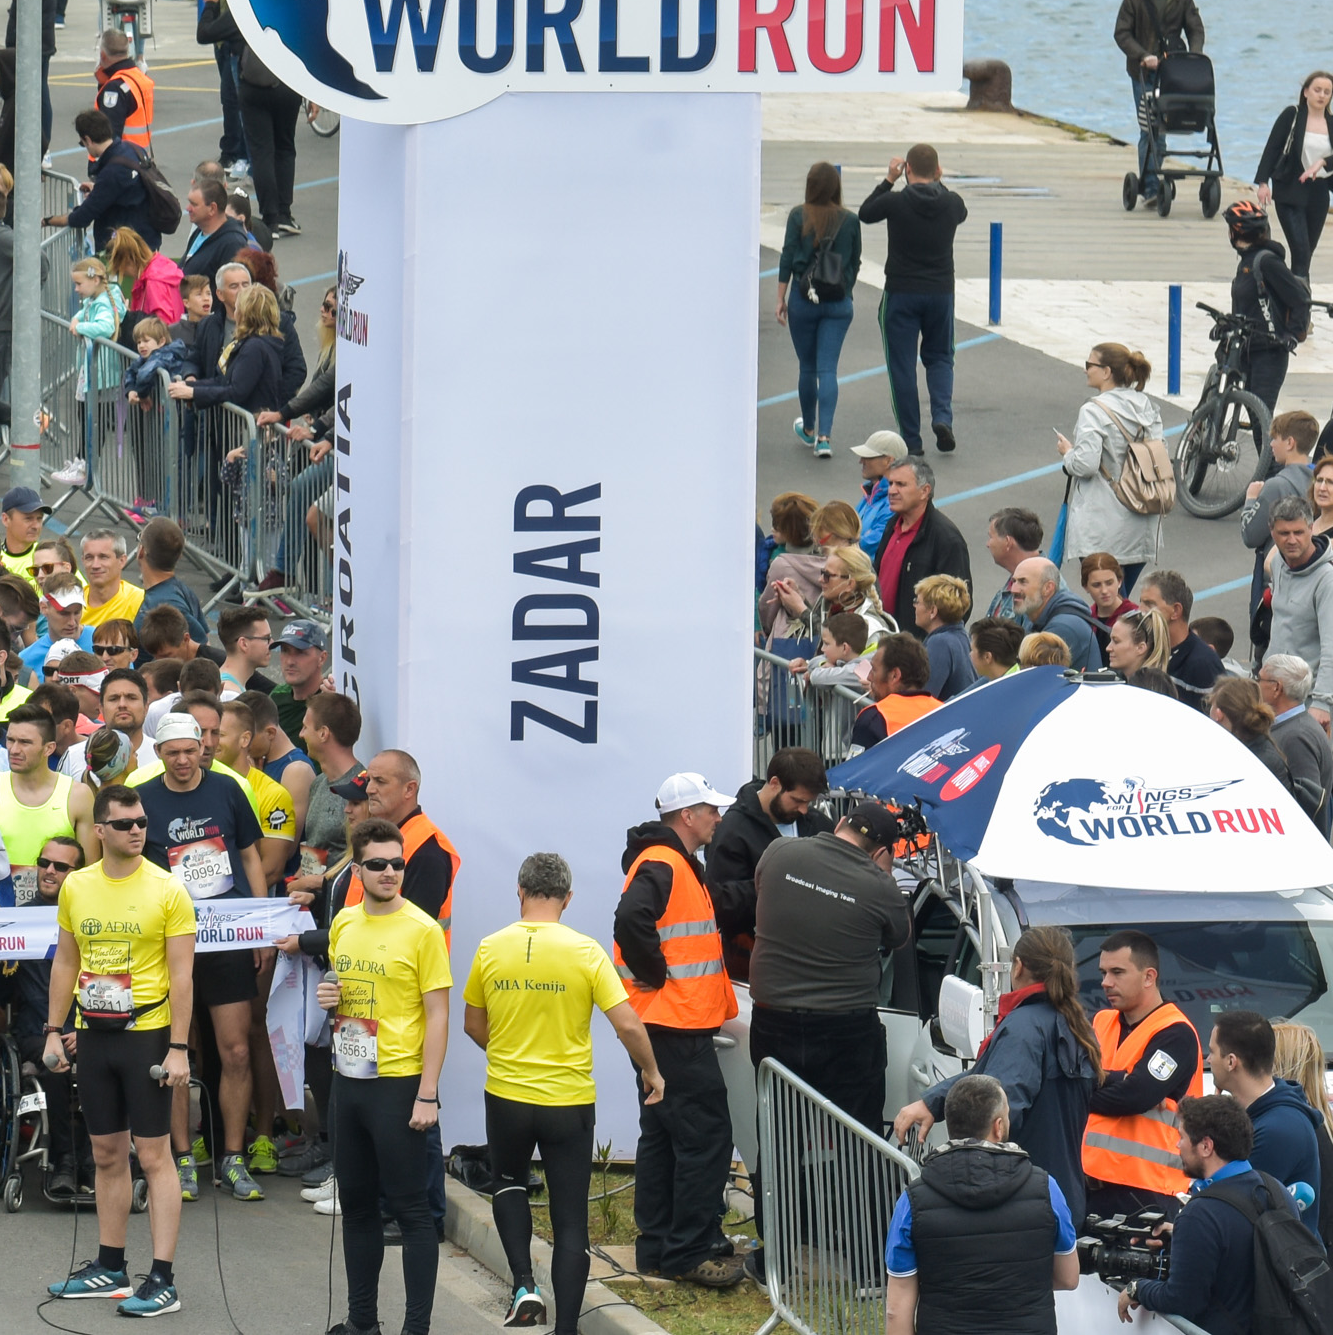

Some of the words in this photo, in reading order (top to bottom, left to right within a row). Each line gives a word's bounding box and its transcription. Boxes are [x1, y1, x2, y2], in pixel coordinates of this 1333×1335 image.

[353, 310, 369, 347] RUN
[335, 382, 361, 712] CROATIA
[510, 481, 603, 745] ZADAR
[1107, 789, 1192, 805] WINGS
[1125, 801, 1171, 815] LIFE
[1079, 811, 1212, 841] WORLD
[1213, 808, 1285, 835] RUN
[177, 827, 205, 841] WORLD
[205, 825, 220, 836] RUN
[184, 863, 223, 883] 50992
[785, 873, 815, 890] Broadcast
[815, 883, 839, 899] Imaging
[839, 892, 856, 904] Team
[104, 922, 141, 935] ADRA
[237, 927, 264, 941] RUN
[0, 936, 25, 951] RUN
[353, 959, 386, 976] ADRA
[493, 979, 521, 991] MIA
[525, 979, 566, 994] Kenija
[337, 1043, 367, 1058] 45563
